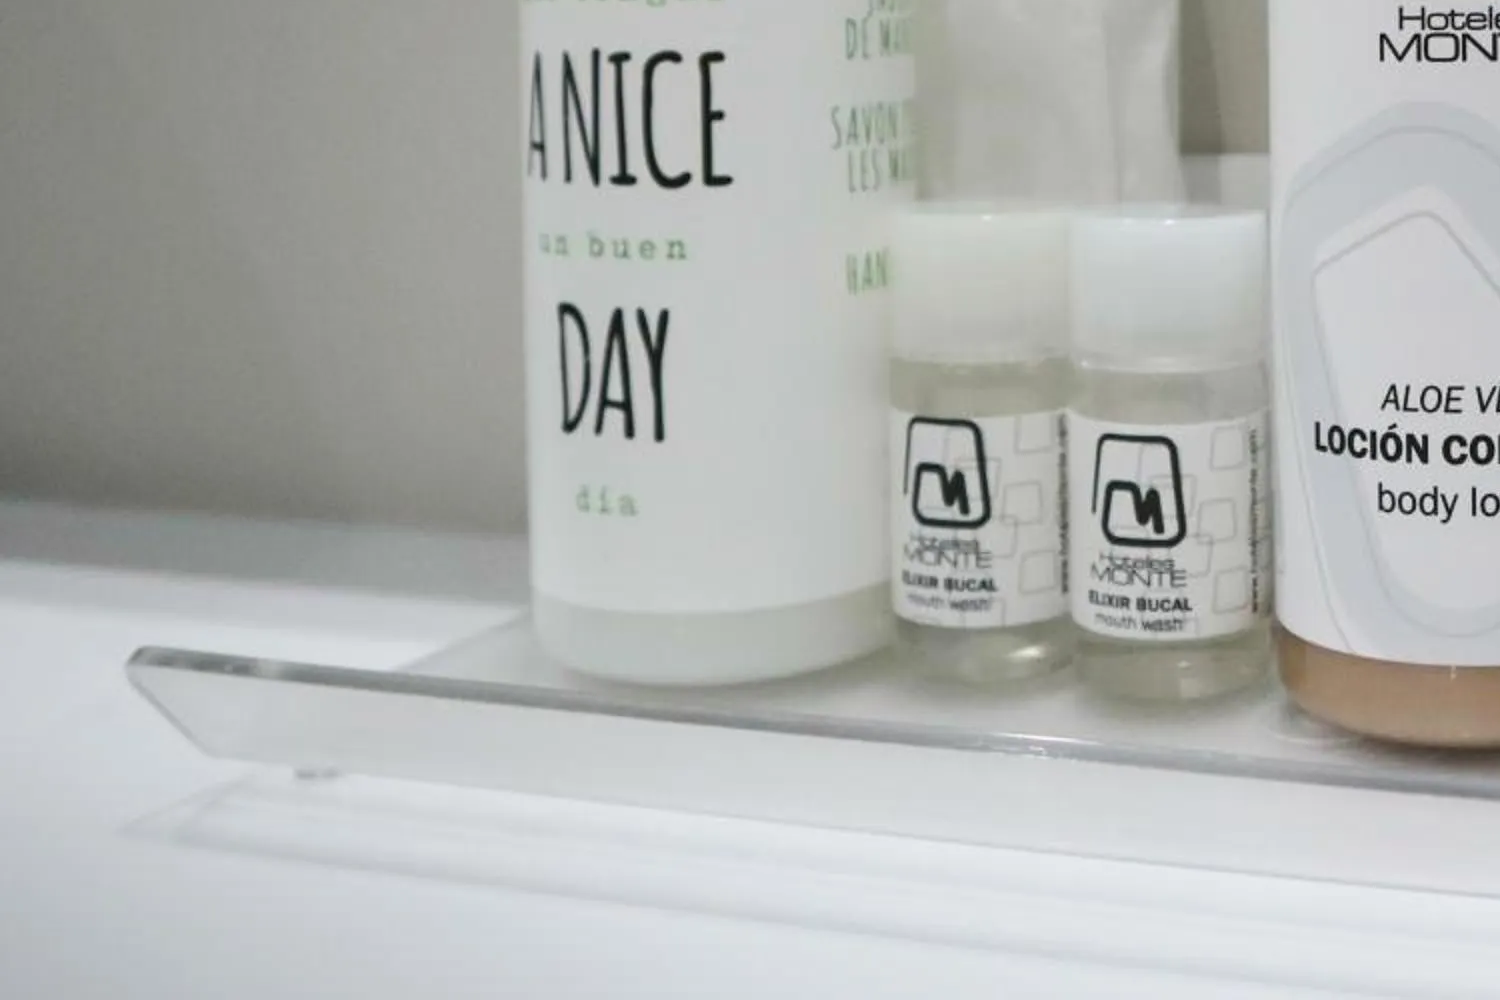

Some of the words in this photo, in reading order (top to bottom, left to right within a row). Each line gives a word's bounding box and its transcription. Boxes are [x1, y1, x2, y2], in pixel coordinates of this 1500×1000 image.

[845, 17, 869, 60] DE
[528, 50, 548, 181] A
[562, 47, 733, 189] NICE
[848, 148, 882, 193] LES
[538, 231, 569, 256] un
[588, 230, 688, 260] buen
[845, 246, 890, 297] HAN
[557, 302, 669, 443] DAY
[1381, 383, 1465, 413] ALOE
[1315, 421, 1429, 463] LOCIÓN
[1378, 482, 1459, 523] body
[904, 545, 992, 569] MONTE
[1090, 562, 1187, 588] MONTE
[944, 577, 998, 593] BUCAL
[1088, 589, 1131, 610] ELIXIR
[1136, 596, 1193, 612] BUCAL
